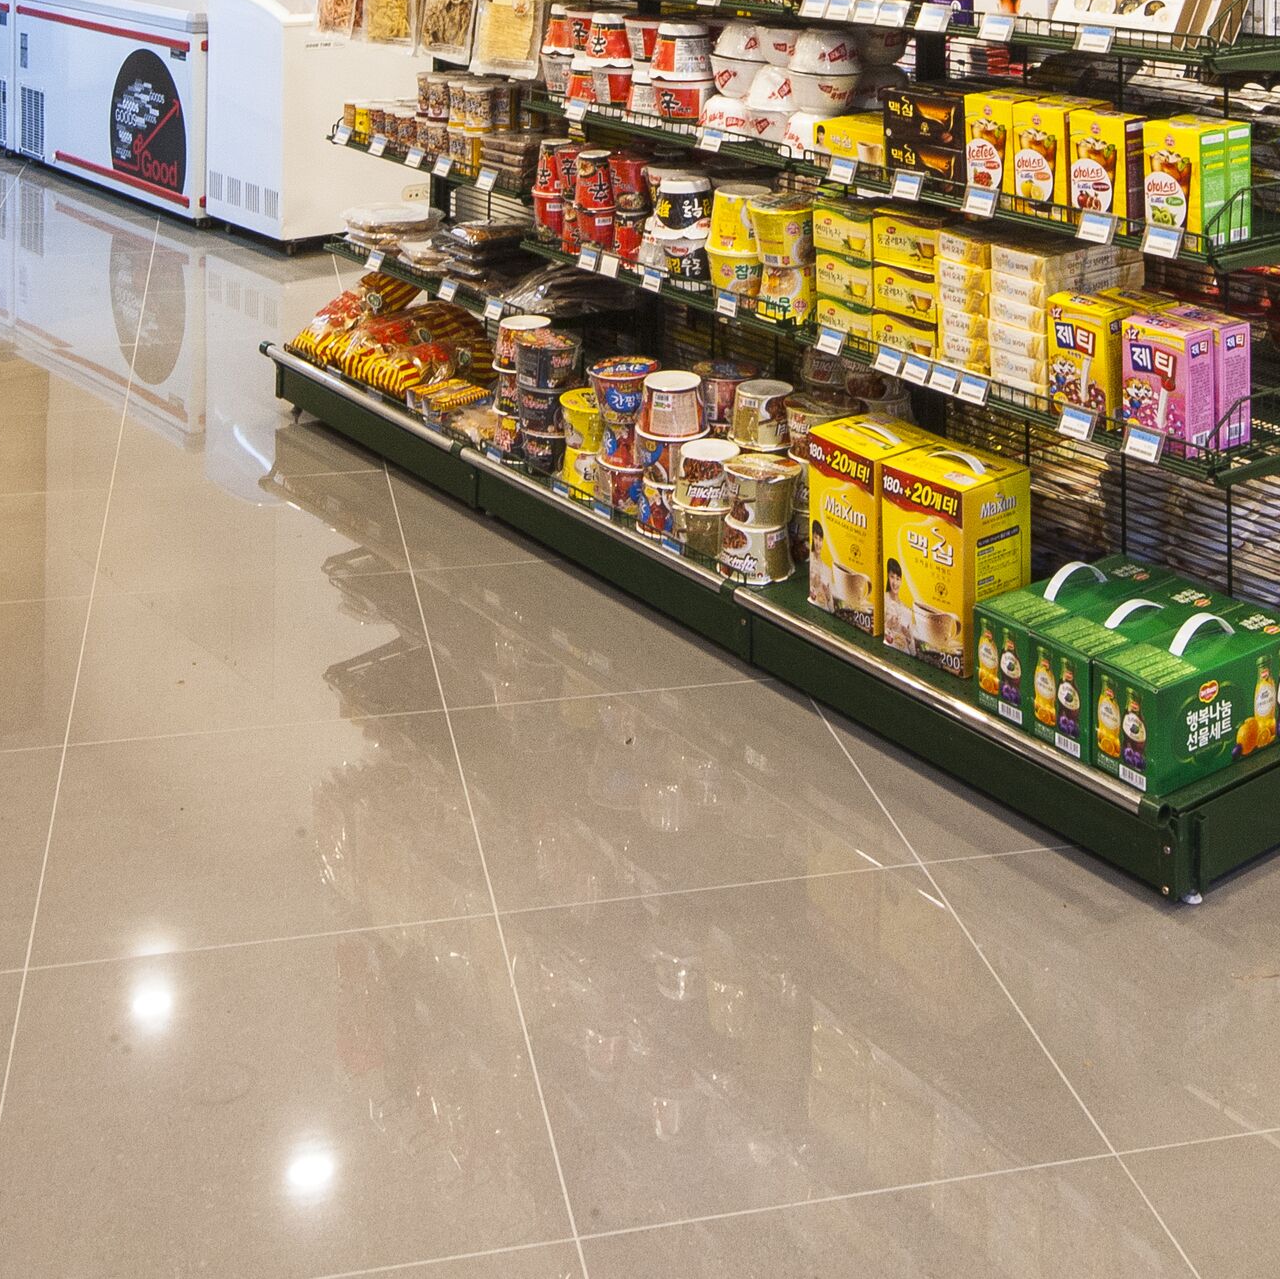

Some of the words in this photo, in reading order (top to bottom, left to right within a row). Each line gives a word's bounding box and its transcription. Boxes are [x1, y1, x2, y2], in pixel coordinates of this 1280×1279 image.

[661, 91, 681, 118] 辛
[888, 99, 914, 120] 맥심
[829, 132, 853, 150] 맥심
[891, 145, 916, 166] 맥심
[1017, 157, 1044, 170] 아이스티
[140, 150, 178, 187] Good
[1074, 167, 1103, 180] 아이스티
[1147, 180, 1177, 193] 아이스티
[877, 232, 908, 247] 둥굴레차
[877, 283, 906, 297] 둥굴레차
[1055, 323, 1095, 357] 제티
[1128, 327, 1138, 339] 12
[1226, 333, 1246, 349] 제티
[1191, 341, 1208, 357] 제티
[1130, 343, 1177, 379] 제티
[858, 464, 870, 483] 더!
[824, 495, 867, 529] Maxim
[942, 495, 958, 516] 더!
[980, 494, 1017, 520] Maxim
[907, 528, 954, 567] 맥심
[940, 653, 961, 670] 200
[1186, 699, 1233, 730] 행복나눔
[1186, 720, 1233, 752] 선물세트
